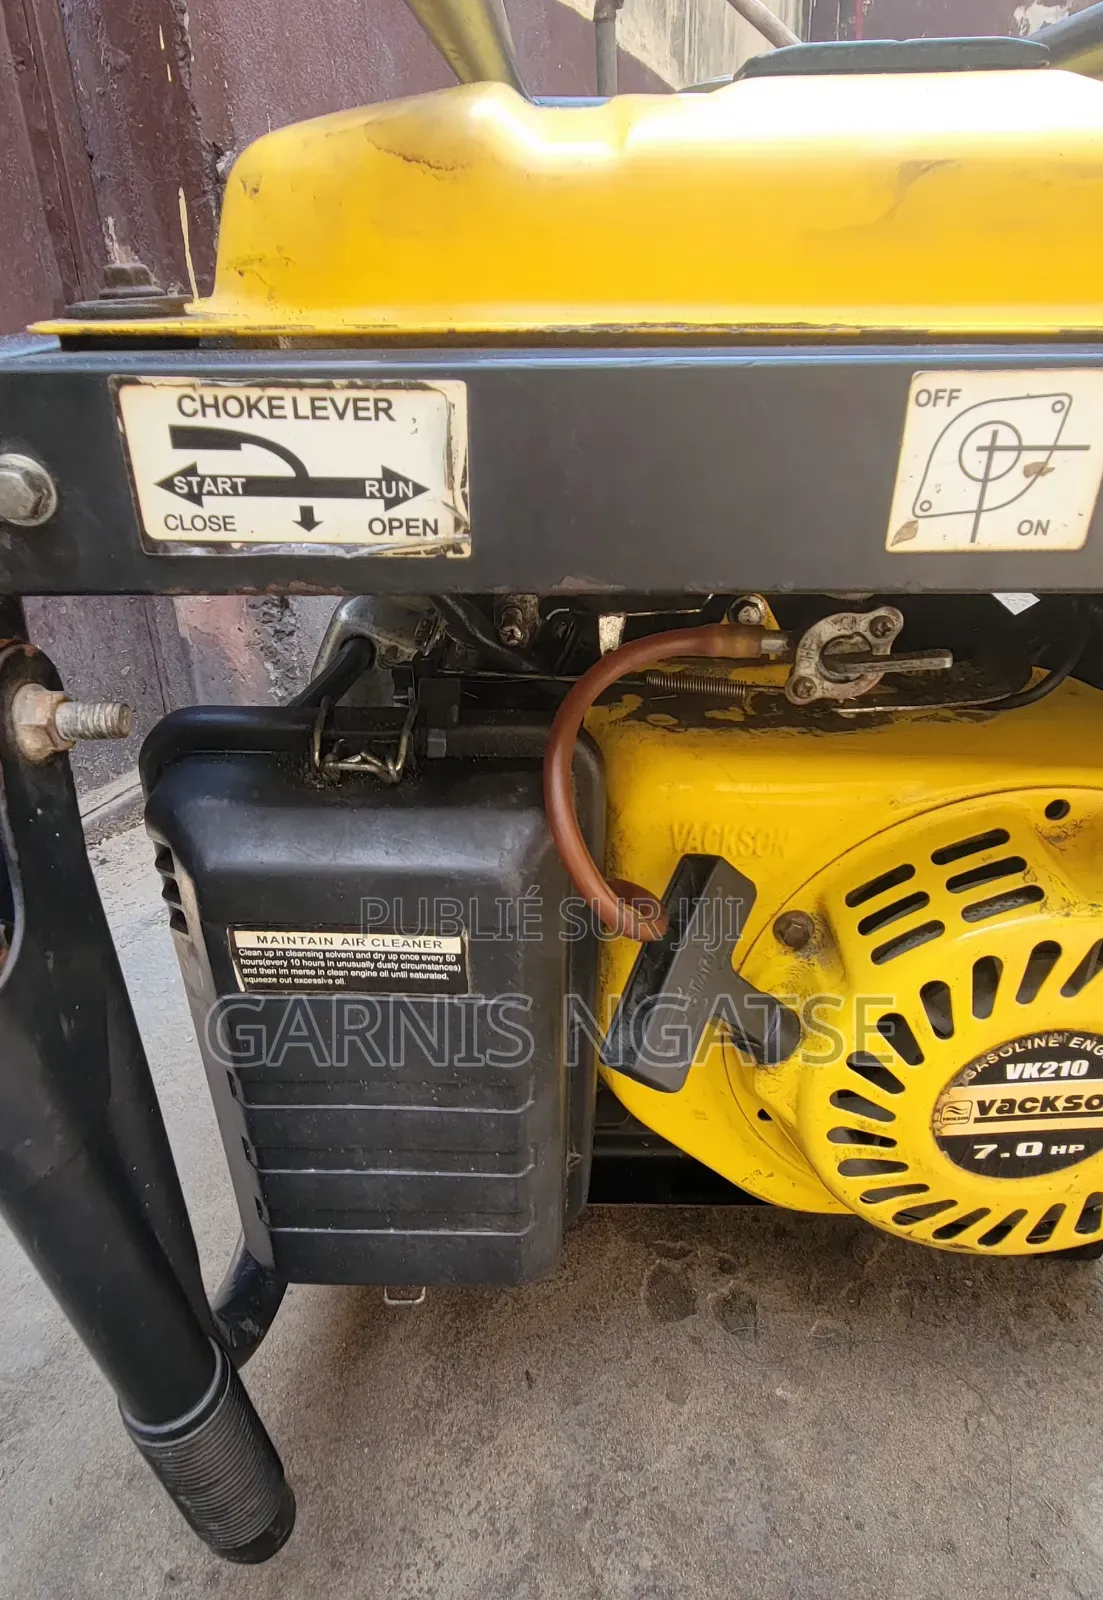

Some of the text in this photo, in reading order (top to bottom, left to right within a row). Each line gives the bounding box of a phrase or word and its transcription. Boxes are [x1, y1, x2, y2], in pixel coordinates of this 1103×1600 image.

[915, 388, 962, 408] OFF
[177, 393, 396, 422] CHOKE LEVER
[173, 476, 247, 496] START
[364, 480, 414, 498] RUN
[163, 513, 237, 532] CLOSE
[368, 517, 439, 536] OPEN
[1017, 519, 1050, 536] ON
[256, 935, 443, 949] MAINTAIN AIR CLEANER
[238, 948, 263, 957] Clean
[263, 950, 275, 959] up
[276, 948, 284, 957] in
[285, 949, 324, 959] cleansing
[325, 951, 354, 959] solvent
[372, 952, 386, 961] dry
[387, 954, 399, 962] up
[421, 955, 444, 963] every
[259, 967, 277, 975] then
[317, 967, 325, 976] in
[326, 968, 348, 976] clean
[350, 970, 378, 978] engine
[302, 959, 325, 967] hours
[336, 961, 375, 969] unusually
[376, 961, 399, 970] dusty
[400, 962, 461, 972] circumstances)
[966, 1036, 1103, 1080] GASOLINE ENG
[1006, 1060, 1089, 1080] VK210
[973, 1142, 1085, 1159] 7.0 HP
